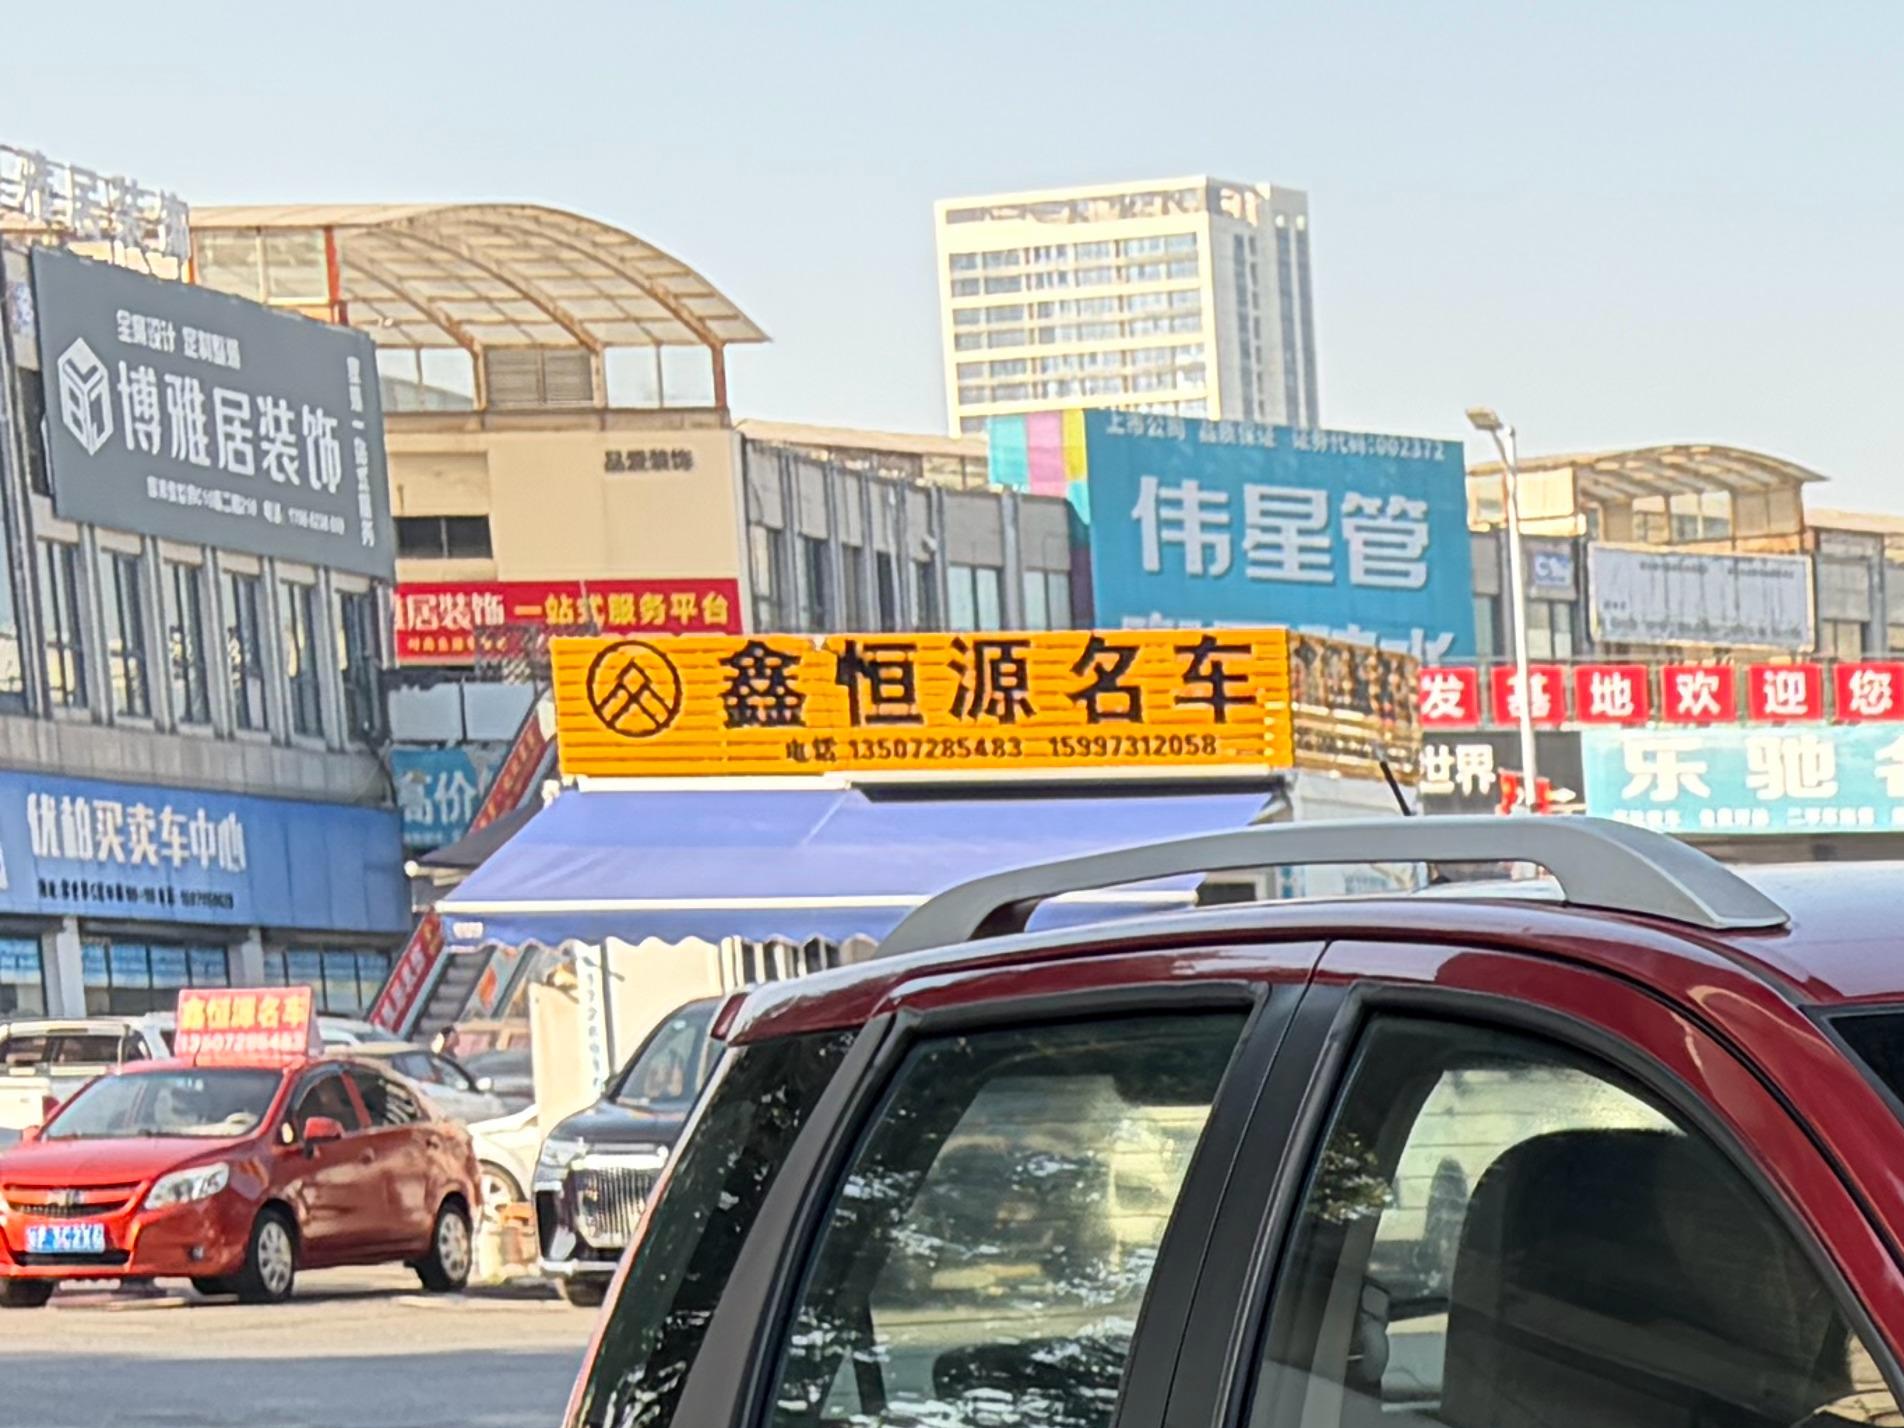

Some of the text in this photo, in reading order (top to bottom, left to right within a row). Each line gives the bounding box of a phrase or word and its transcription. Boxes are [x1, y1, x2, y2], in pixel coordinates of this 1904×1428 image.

[117, 360, 342, 494] 博雅居装饰
[1131, 476, 1430, 588] 伟星管
[514, 591, 730, 626] 一站式服务平台
[718, 636, 1258, 729] 鑫恒源名车
[786, 734, 1218, 763] 电话 13507285483 15997312058
